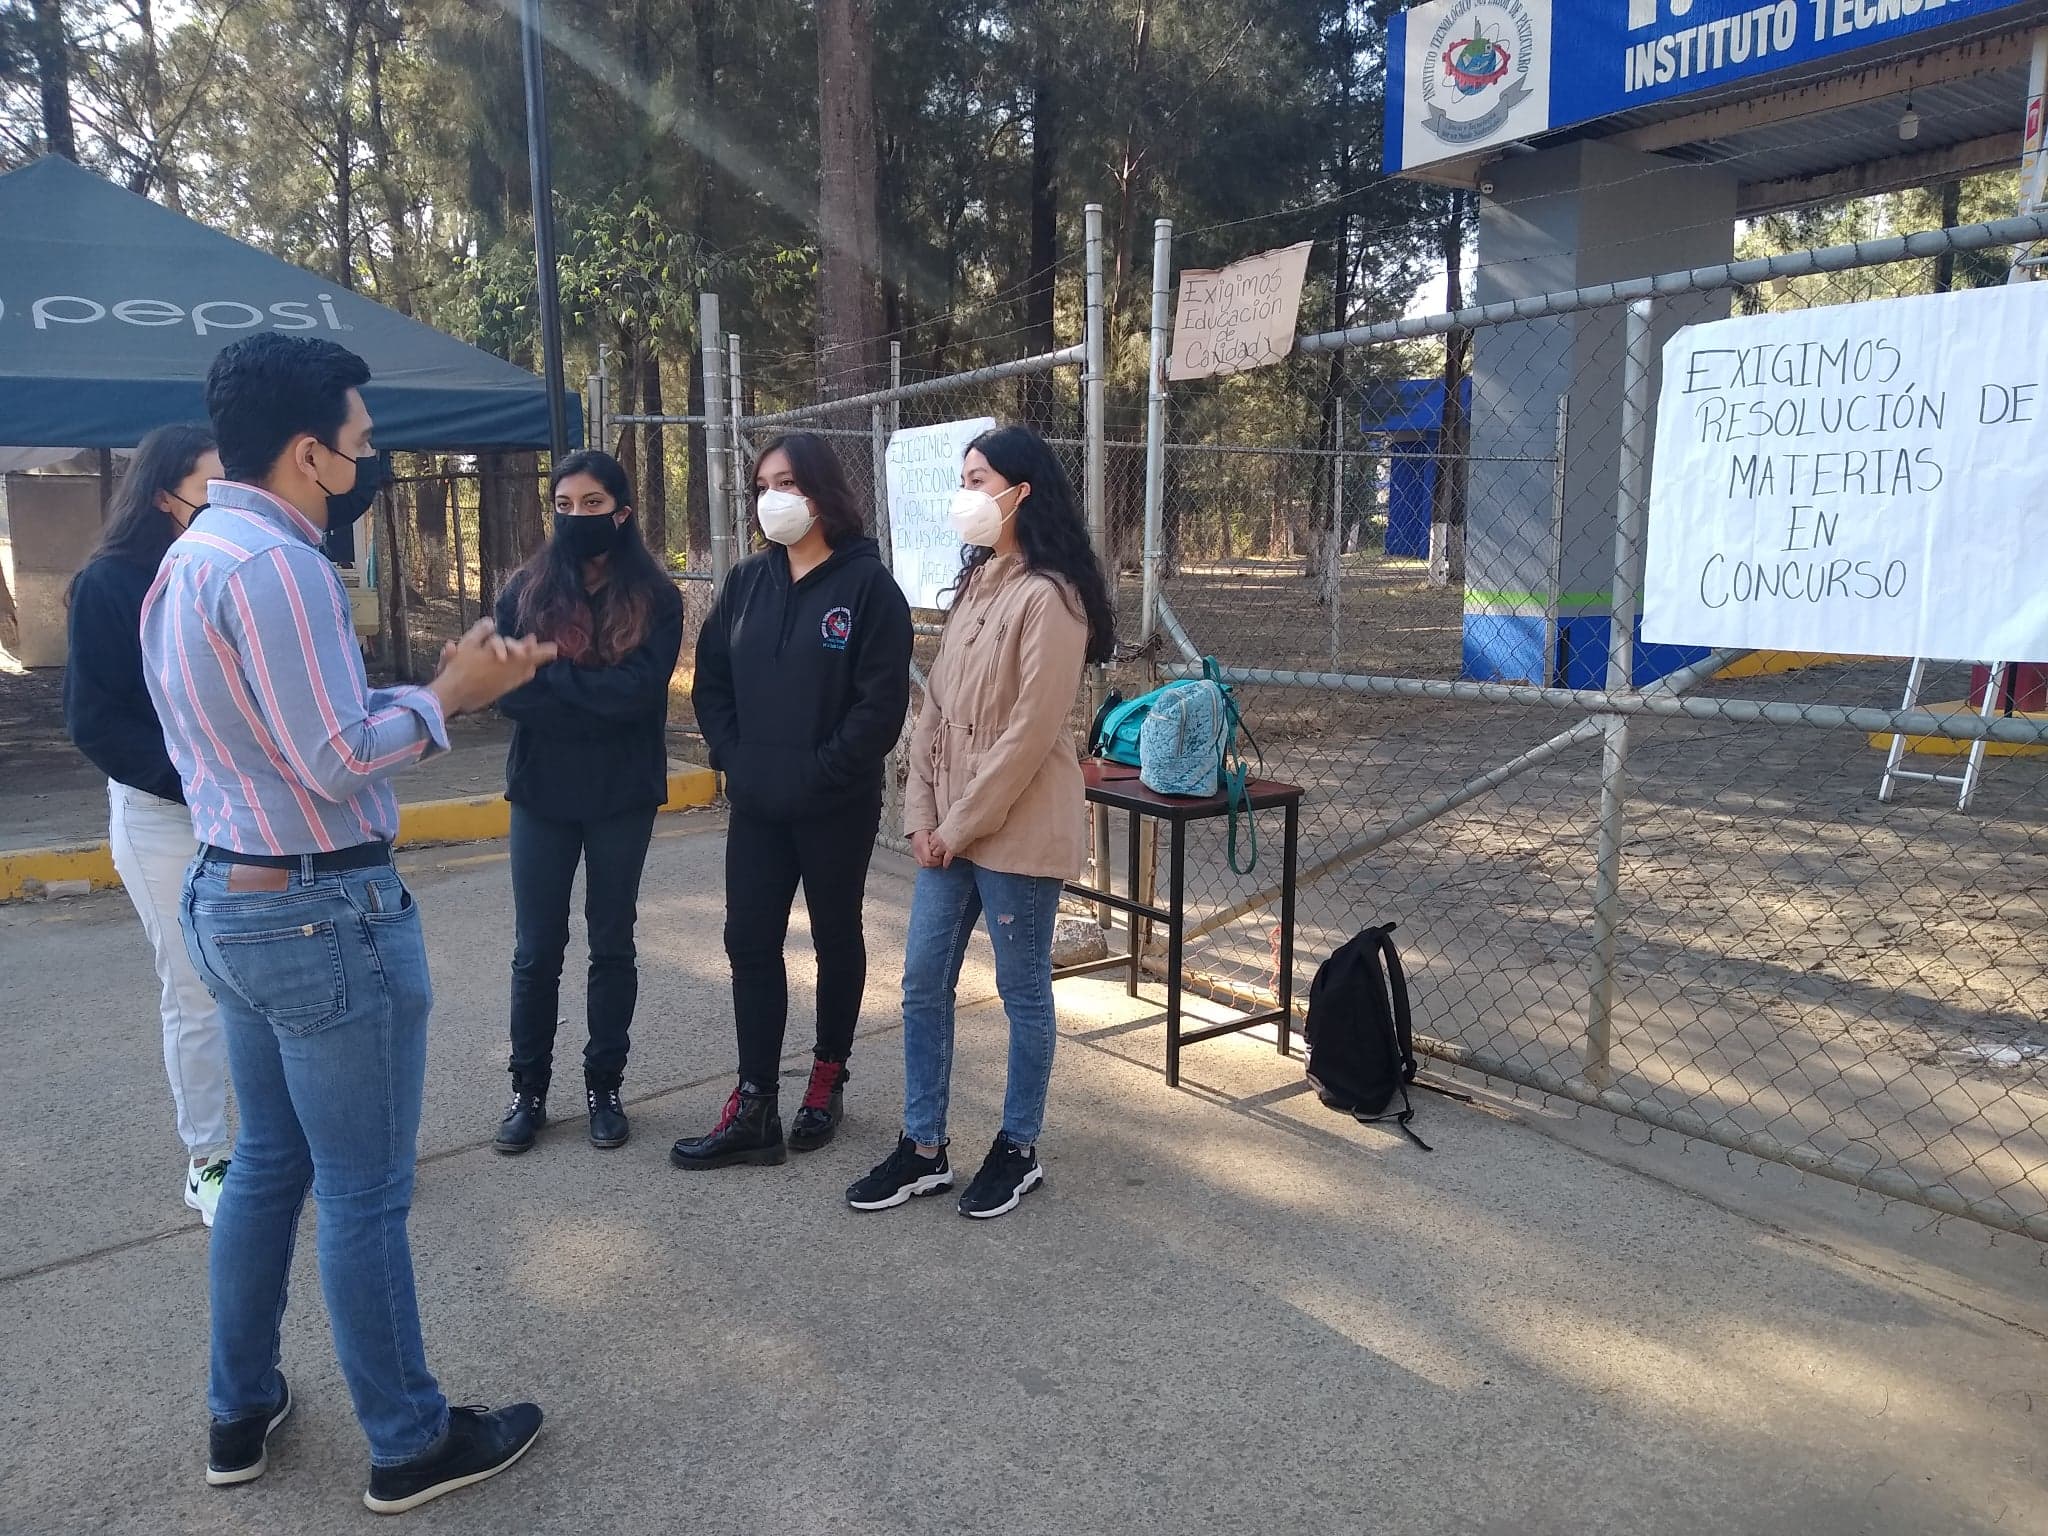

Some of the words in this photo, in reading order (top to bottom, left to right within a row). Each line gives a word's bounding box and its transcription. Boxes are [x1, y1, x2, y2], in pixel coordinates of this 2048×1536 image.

[1624, 1, 1798, 93] INSTITUTO
[1181, 294, 1282, 330] Educación
[1183, 268, 1282, 312] Exigimos
[32, 293, 344, 336] pepsi
[1216, 326, 1235, 342] de
[1682, 338, 1901, 394] EXIGIMOS
[1695, 382, 1946, 443] RESOLUCIÓN
[1978, 383, 2039, 424] DE
[899, 465, 961, 494] PERSONA
[1728, 447, 1944, 499] MATERIAS
[1780, 505, 1839, 552] EN
[1700, 552, 1907, 609] CONCURSO
